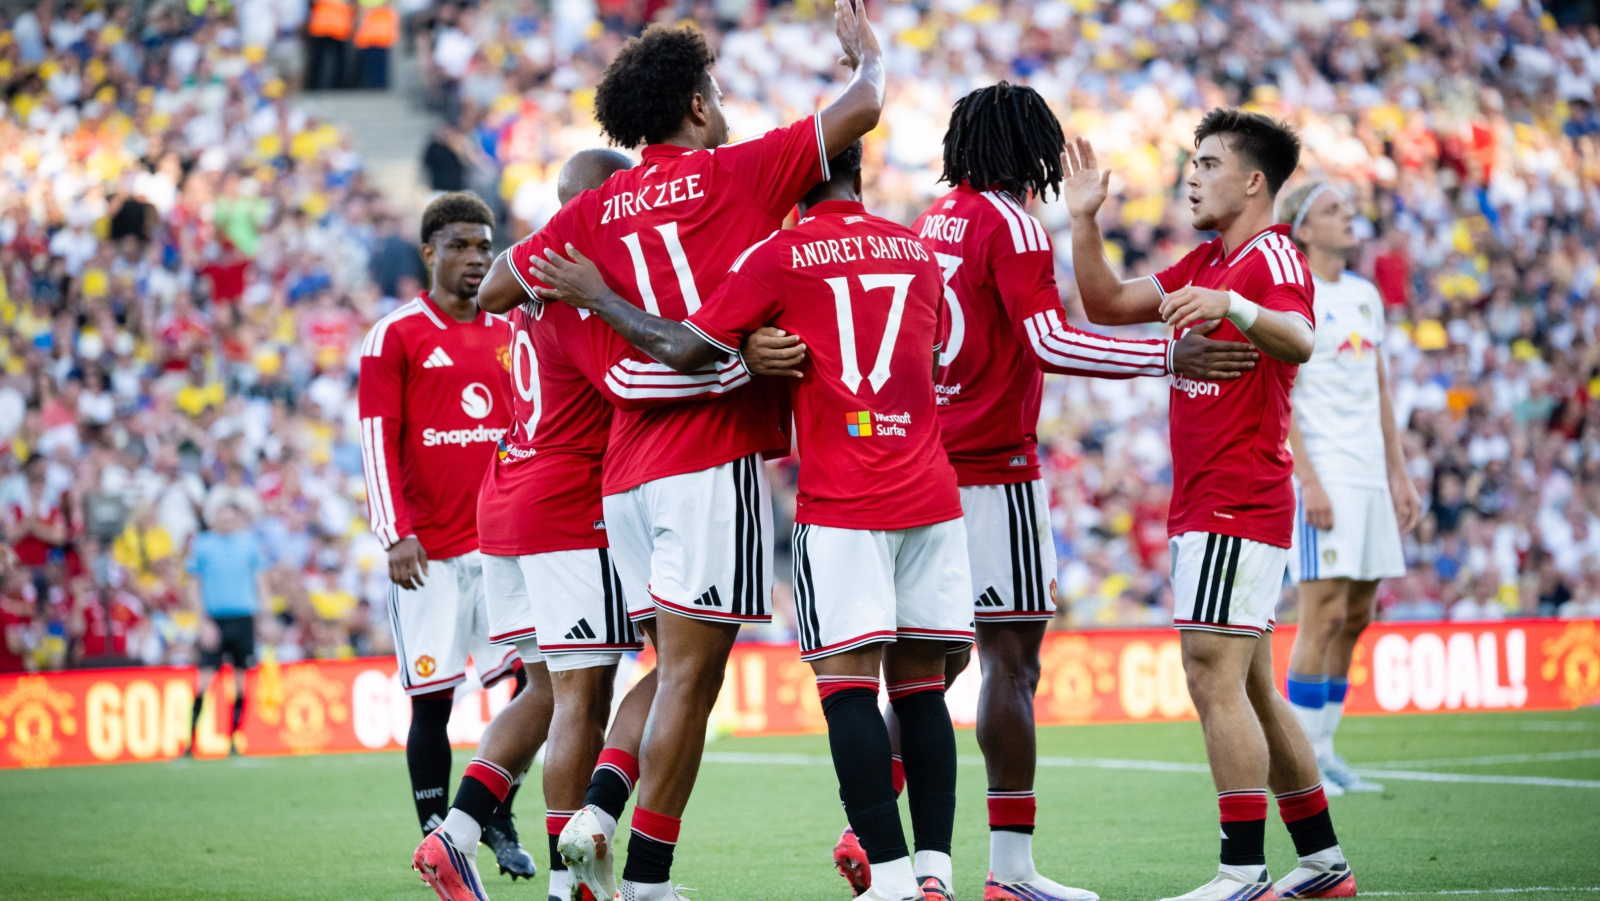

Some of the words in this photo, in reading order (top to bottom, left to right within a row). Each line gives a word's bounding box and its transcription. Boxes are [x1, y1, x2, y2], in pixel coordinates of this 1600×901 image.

[600, 174, 704, 225] ZIRKZEE
[919, 214, 969, 244] DORGU
[620, 221, 702, 317] 11
[791, 236, 865, 269] ANDREY
[867, 235, 929, 262] SANTOS
[823, 273, 916, 395] 17
[876, 424, 906, 437] Surface
[1373, 628, 1528, 711] GOAL!
[415, 787, 444, 800] MUFC
